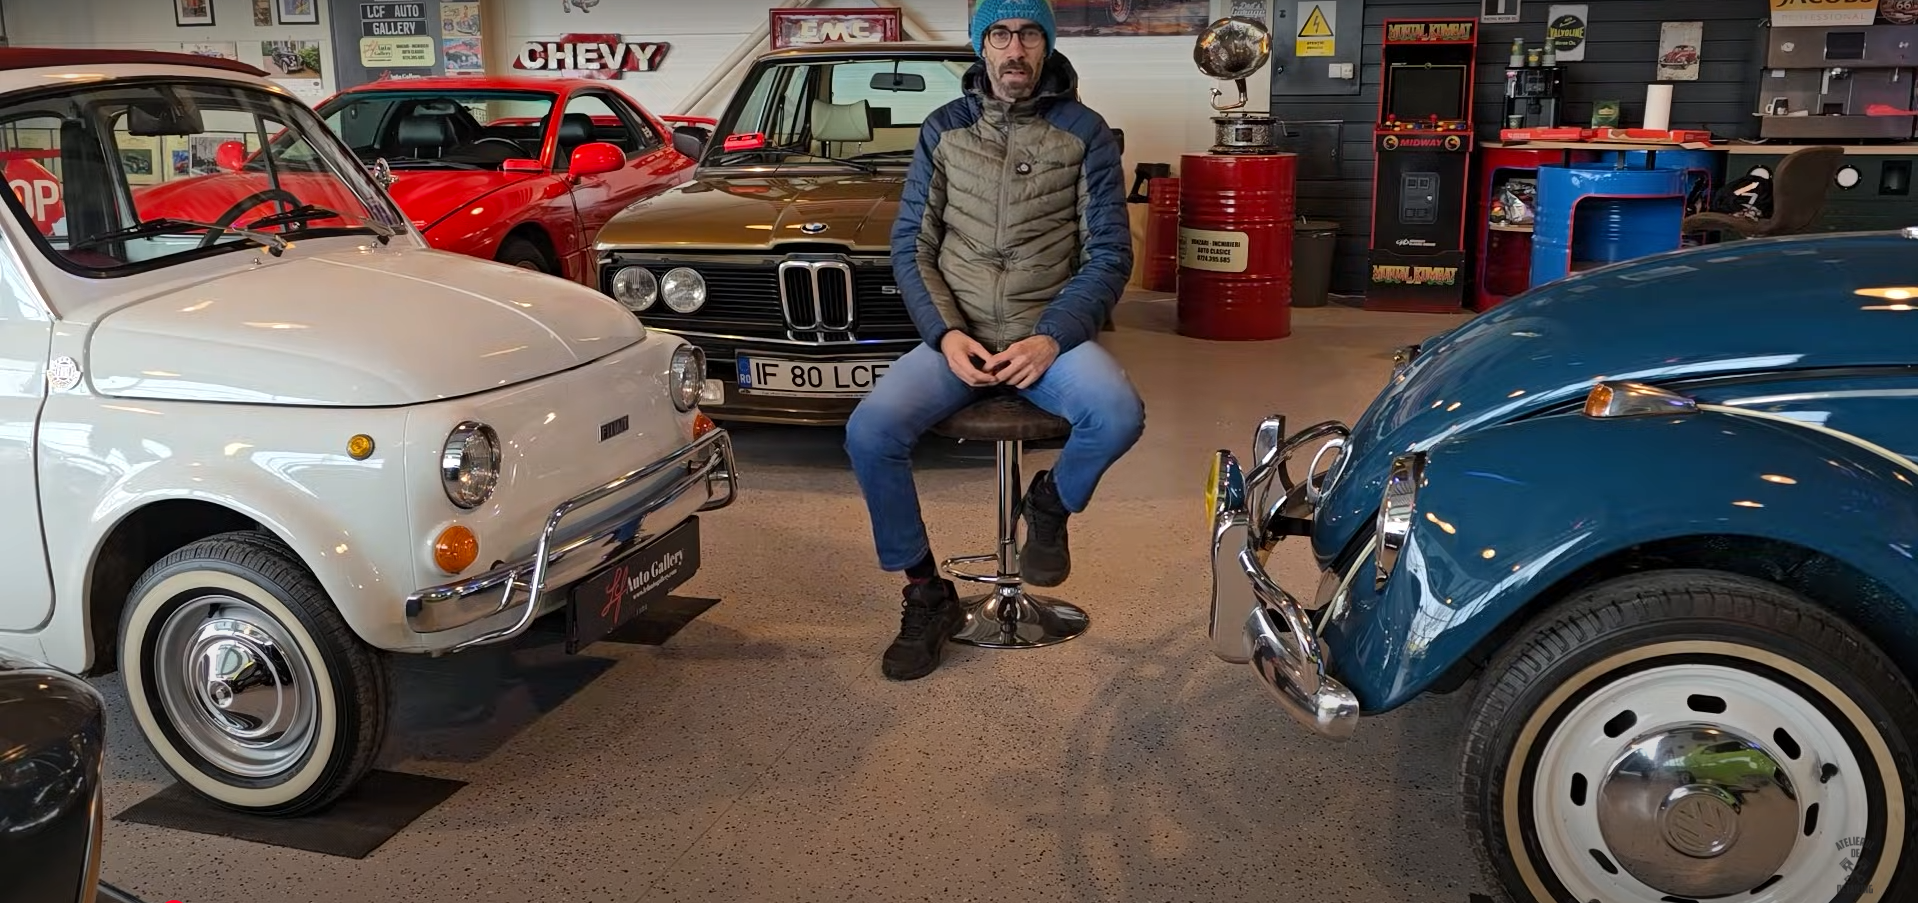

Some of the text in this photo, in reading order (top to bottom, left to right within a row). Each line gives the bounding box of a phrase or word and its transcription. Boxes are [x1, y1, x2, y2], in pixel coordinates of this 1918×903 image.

[366, 4, 419, 18] LCF AUTO
[372, 21, 416, 35] GALLERY
[794, 20, 876, 43] GMC
[1388, 23, 1472, 40] MORTAL KOMBAT
[1549, 27, 1585, 38] VALVOLINE
[519, 42, 657, 70] CHEVY
[1400, 138, 1443, 147] MIDWAY
[9, 179, 60, 221] OP
[881, 285, 901, 294] 5
[740, 373, 751, 384] RO
[756, 362, 890, 389] IF 80 LCF
[626, 569, 650, 594] Auto
[651, 548, 684, 579] Gallery
